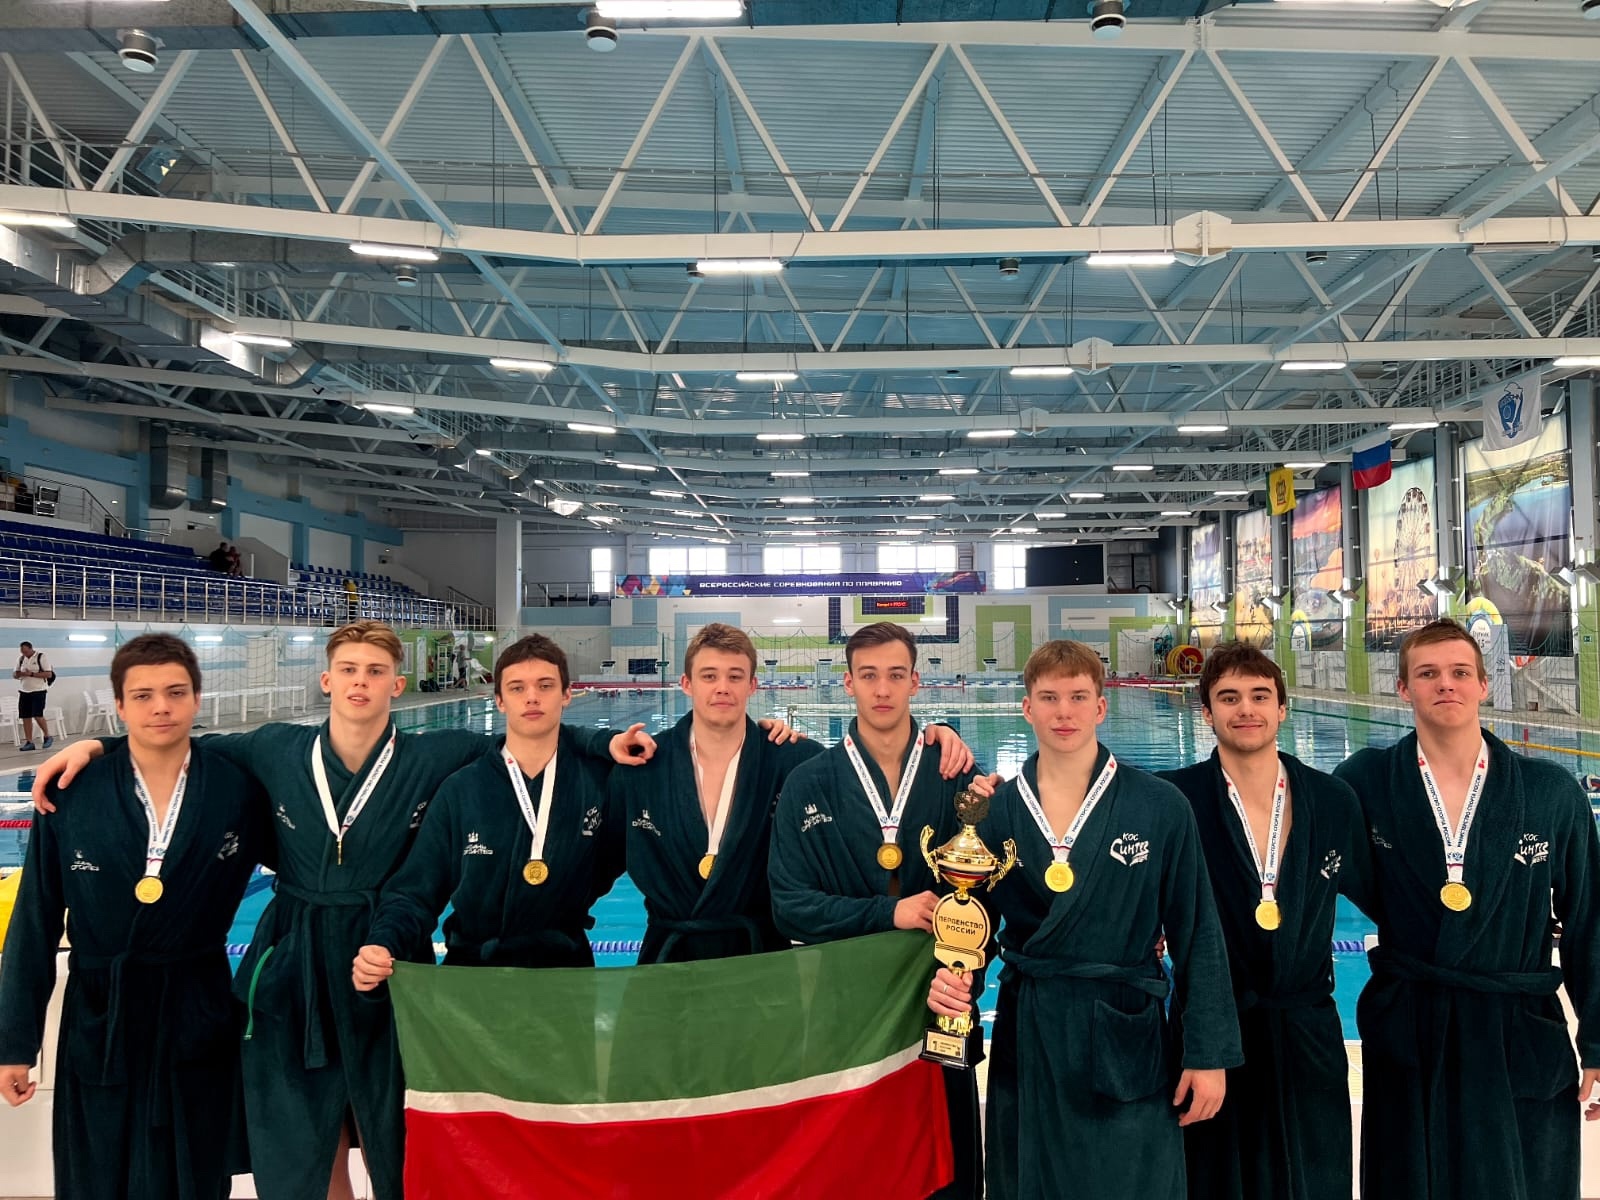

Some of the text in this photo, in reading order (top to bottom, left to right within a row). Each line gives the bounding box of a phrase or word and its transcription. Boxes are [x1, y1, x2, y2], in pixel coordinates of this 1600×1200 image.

[699, 580, 771, 588] ВСЕРОССИЙСКИЕ
[773, 580, 840, 588] СОРЕВНОВАНИЯ
[1122, 832, 1139, 842] КОС
[1523, 833, 1540, 842] КОС
[938, 915, 984, 930] ПЕРВЕНСТВО
[946, 924, 976, 936] РОССИИ
